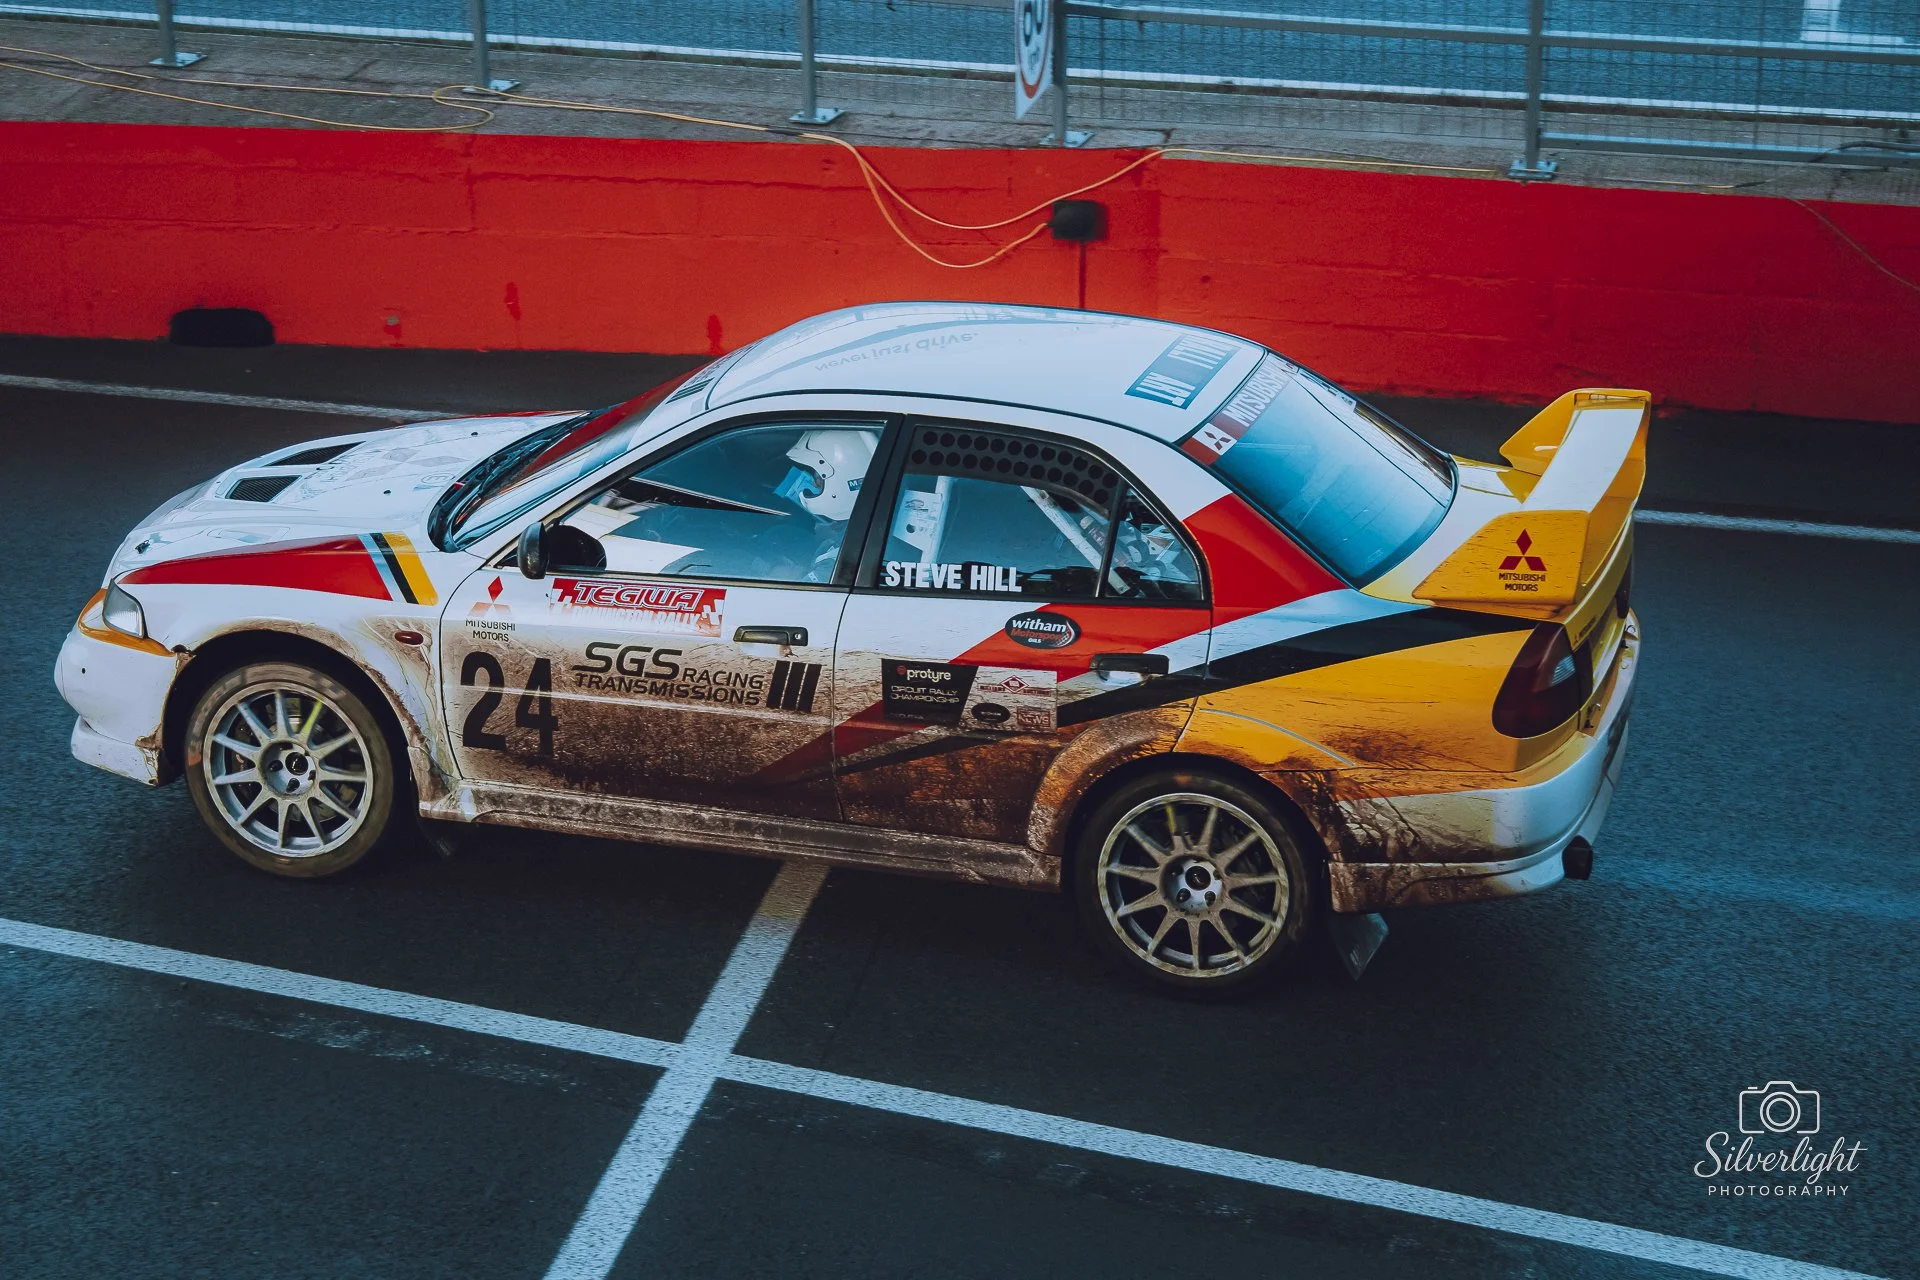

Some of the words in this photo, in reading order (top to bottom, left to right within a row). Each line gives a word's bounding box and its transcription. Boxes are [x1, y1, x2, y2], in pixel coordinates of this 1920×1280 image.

[885, 560, 962, 590] STEVE
[970, 564, 1023, 593] HILL
[1498, 572, 1546, 582] MITSUBISHI
[1504, 583, 1539, 592] MOTORS
[574, 582, 705, 612] TEGIWA
[465, 619, 516, 631] MITSUBISHI
[1012, 618, 1067, 633] witham
[472, 630, 509, 642] MOTORS
[572, 641, 683, 681] SGS
[682, 667, 765, 690] RACING
[906, 668, 952, 683] protyre
[575, 672, 761, 706] TRANSMISSIONS
[929, 688, 958, 696] RALLY
[460, 651, 559, 757] 24
